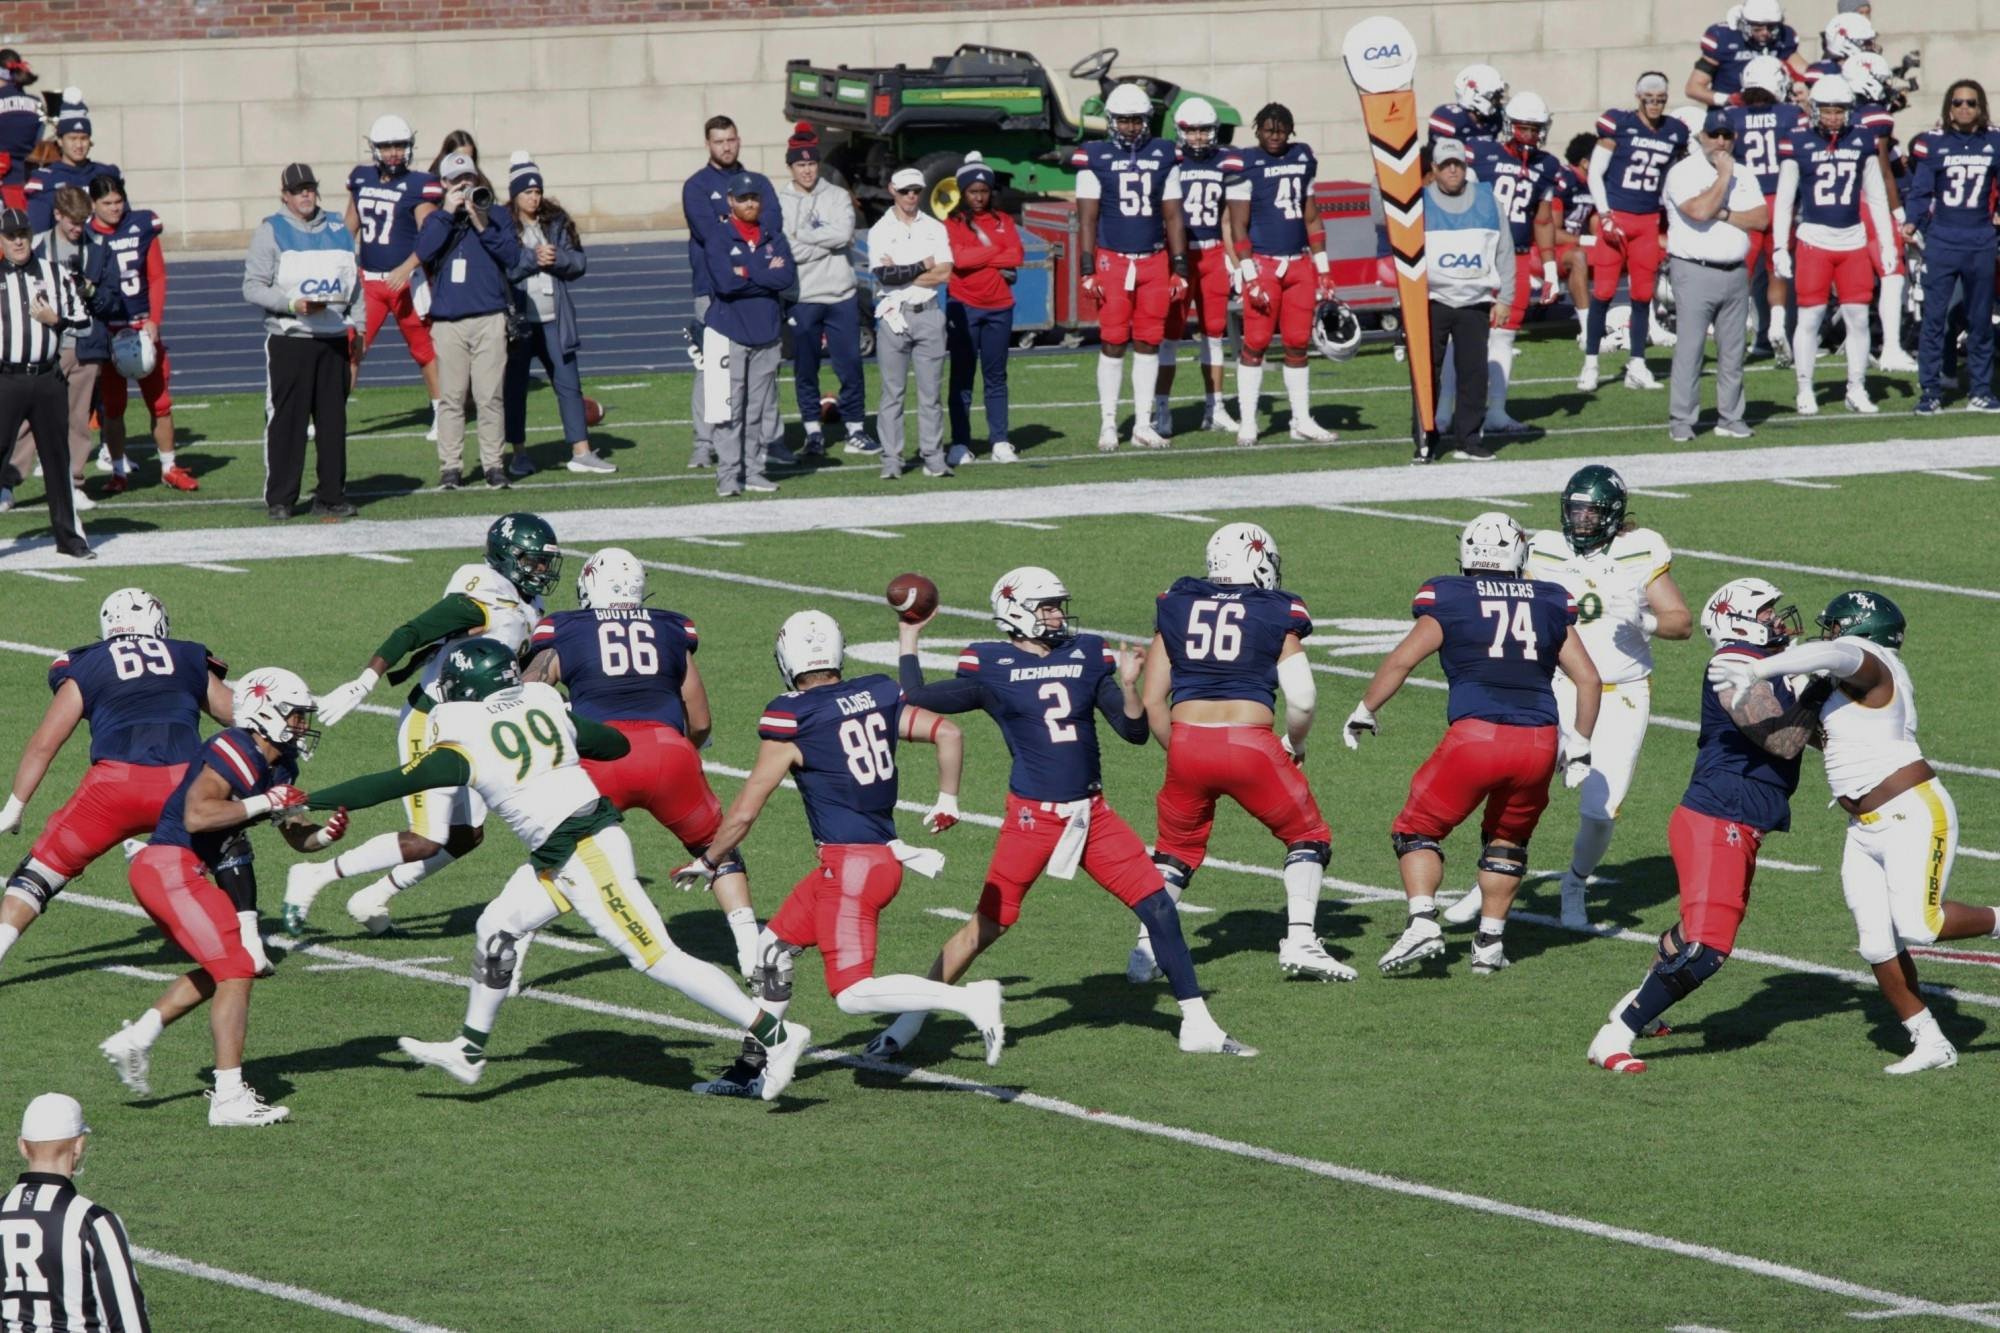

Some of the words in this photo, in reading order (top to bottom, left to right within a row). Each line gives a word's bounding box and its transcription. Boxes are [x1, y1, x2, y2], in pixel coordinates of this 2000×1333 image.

[1364, 44, 1401, 61] CAA
[1745, 113, 1777, 129] HAYES
[1622, 150, 1670, 192] 25
[1744, 130, 1779, 175] 21
[1119, 172, 1153, 217] 51
[1183, 182, 1223, 227] 49
[1274, 177, 1303, 219] 41
[1494, 175, 1534, 224] 92
[1814, 162, 1857, 206] 27
[1943, 165, 1988, 209] 37
[358, 198, 395, 245] 57
[117, 250, 140, 297] 5
[1439, 253, 1482, 269] CAA
[300, 278, 342, 295] CAA
[464, 576, 480, 592] 8
[1471, 561, 1500, 569] SPIDERS
[1476, 581, 1535, 599] SALYERS
[598, 621, 659, 676] 66
[1186, 600, 1246, 661] 56
[1480, 600, 1538, 661] 74
[108, 638, 175, 681] 69
[1010, 664, 1083, 682] RICHMOND
[486, 700, 524, 715] LYNN
[836, 691, 876, 716] CLOSE
[1038, 681, 1078, 743] 2
[491, 708, 564, 783] 99
[839, 712, 894, 786] 86
[1928, 836, 1945, 906] TRIBE
[601, 882, 653, 947] TRIBE
[0, 1219, 49, 1292] R
